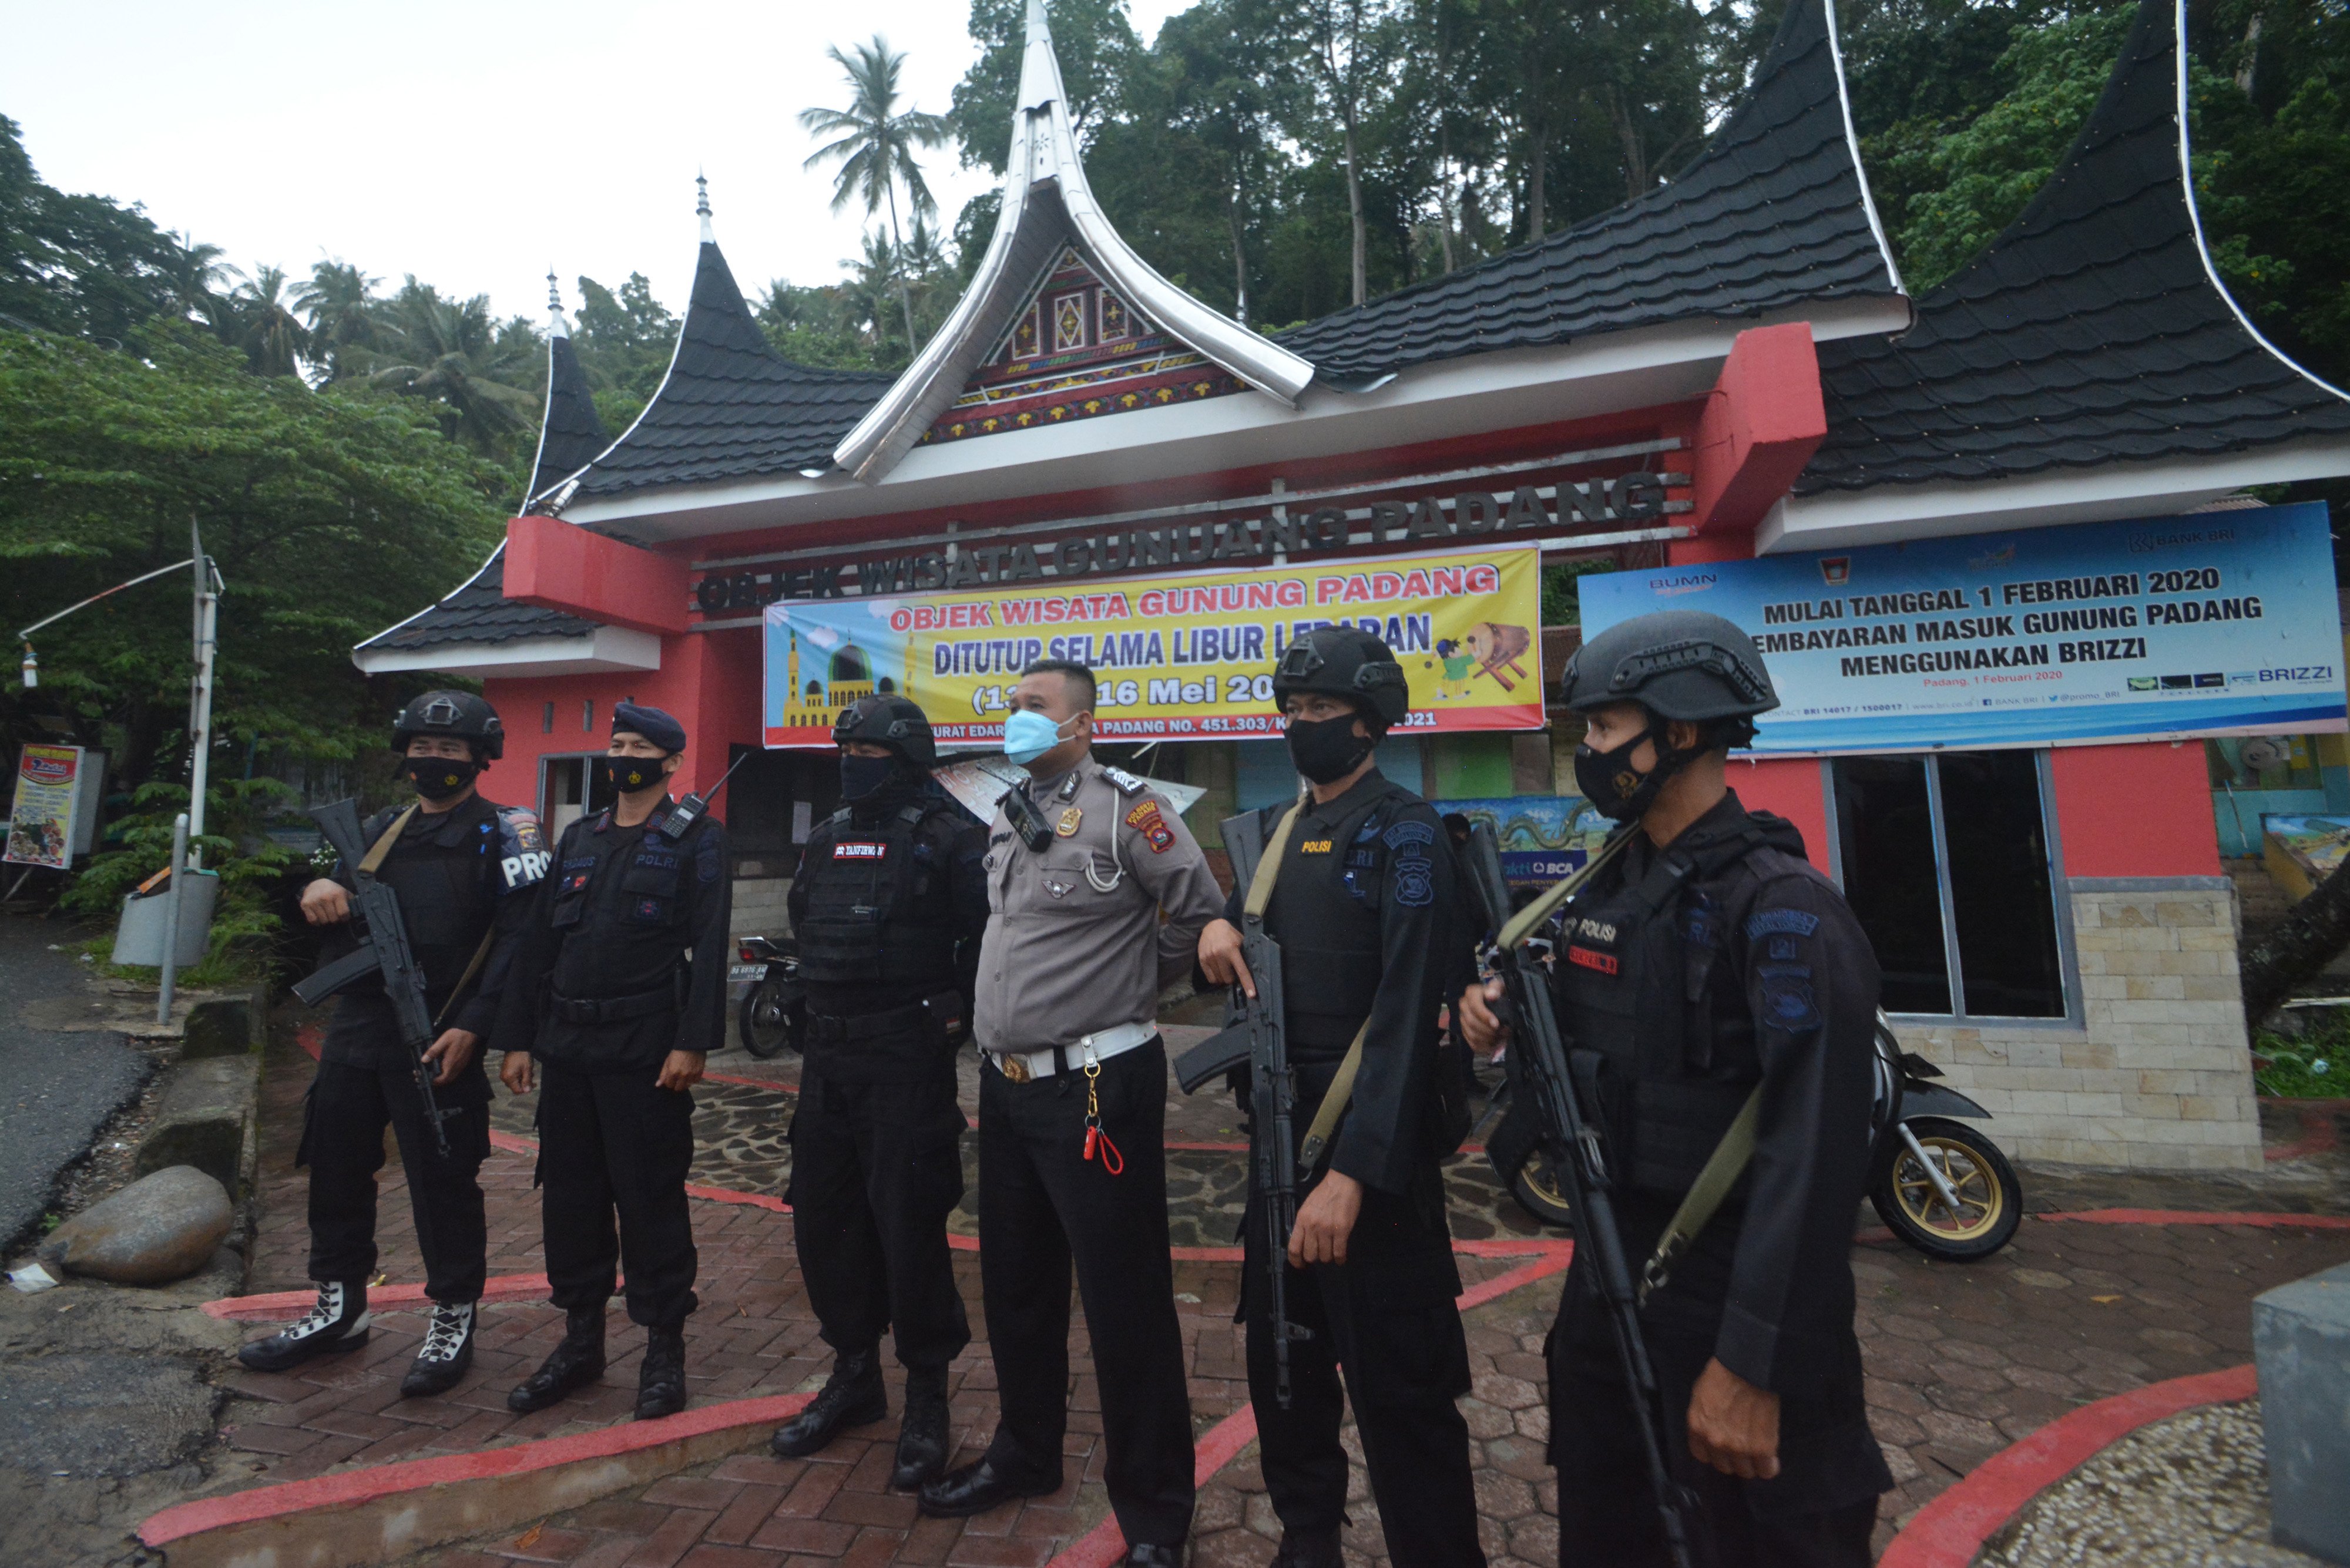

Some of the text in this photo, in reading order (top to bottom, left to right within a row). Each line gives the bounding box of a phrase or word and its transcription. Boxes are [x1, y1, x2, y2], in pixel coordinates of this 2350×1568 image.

[696, 469, 1664, 611] OBJEK WISATA GUNUANG PADANG
[2157, 528, 2234, 545] BANK BRI
[1650, 573, 1717, 589] BUMN
[889, 564, 1500, 632] OBJEK WISATA GUNUNG PADANG
[1764, 568, 2220, 624] MULAI TANGGAL 1 FEBRUARI 2020
[1751, 596, 2261, 653] EMBAYARAN MASUK GUNUNG PADANG
[934, 637, 1042, 677] DITUTUP
[1049, 629, 1166, 670] SELAMA
[1173, 623, 1265, 666] LIBUR
[1841, 637, 2146, 677] MENGGUNAKAN BRIZZI
[1923, 679, 1969, 687] Padang,
[1984, 674, 2031, 683] Februari
[2036, 671, 2063, 680] 2020
[2259, 666, 2332, 682] BRIZZI
[1149, 675, 1217, 705] Mei
[1103, 720, 1165, 734] PADANG
[1169, 718, 1197, 732] NO.
[1200, 716, 1287, 733] 451.303/K
[1395, 712, 1437, 726] 021
[932, 724, 1005, 738] URAT EDAR
[1301, 840, 1332, 853] POLISI
[636, 855, 678, 868] POLRI
[1547, 862, 1573, 874] BCA
[1579, 918, 1616, 942] POLISI
